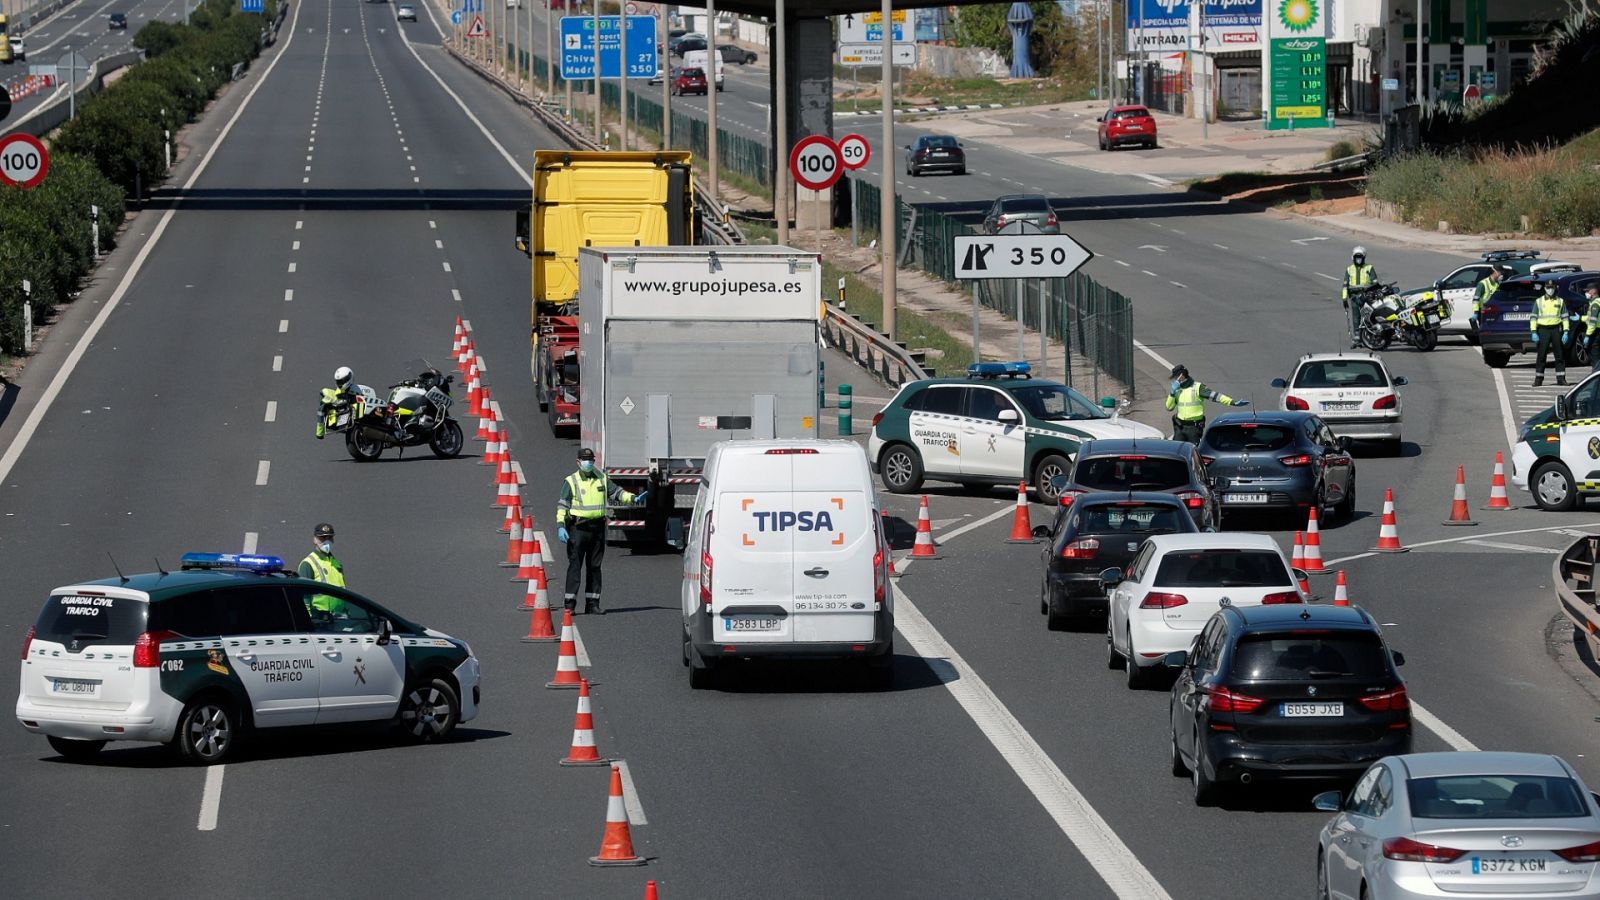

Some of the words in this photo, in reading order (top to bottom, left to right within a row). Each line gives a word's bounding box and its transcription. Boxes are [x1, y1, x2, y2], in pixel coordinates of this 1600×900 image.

[1137, 35, 1186, 46] ENTRADA
[1286, 39, 1319, 50] shop
[638, 54, 652, 63] 27
[631, 64, 652, 73] 350
[844, 146, 863, 158] 50
[3, 152, 39, 171] 100
[800, 154, 836, 173] 100
[1010, 247, 1066, 266] 350
[624, 278, 802, 296] www.grupojupesa.es
[914, 429, 941, 439] GUARDIA
[941, 431, 957, 440] CIVIL
[752, 510, 834, 532] TIPSA
[60, 596, 93, 606] GUARDIA
[92, 598, 114, 608] CIVIL
[795, 602, 807, 610] 96
[809, 602, 824, 610] 134
[825, 602, 837, 610] 30
[838, 602, 848, 610] 75
[65, 606, 99, 617] TRAFICO
[733, 619, 757, 629] 2583
[759, 619, 778, 629] LBP
[168, 659, 184, 672] 062
[250, 661, 291, 672] GUARDIA
[292, 658, 315, 670] CIVIL
[264, 669, 304, 683] TRÁFICO
[1287, 704, 1316, 715] 6059
[1320, 704, 1342, 715] JXB
[1481, 860, 1516, 872] 6372
[1519, 860, 1546, 872] KGM
